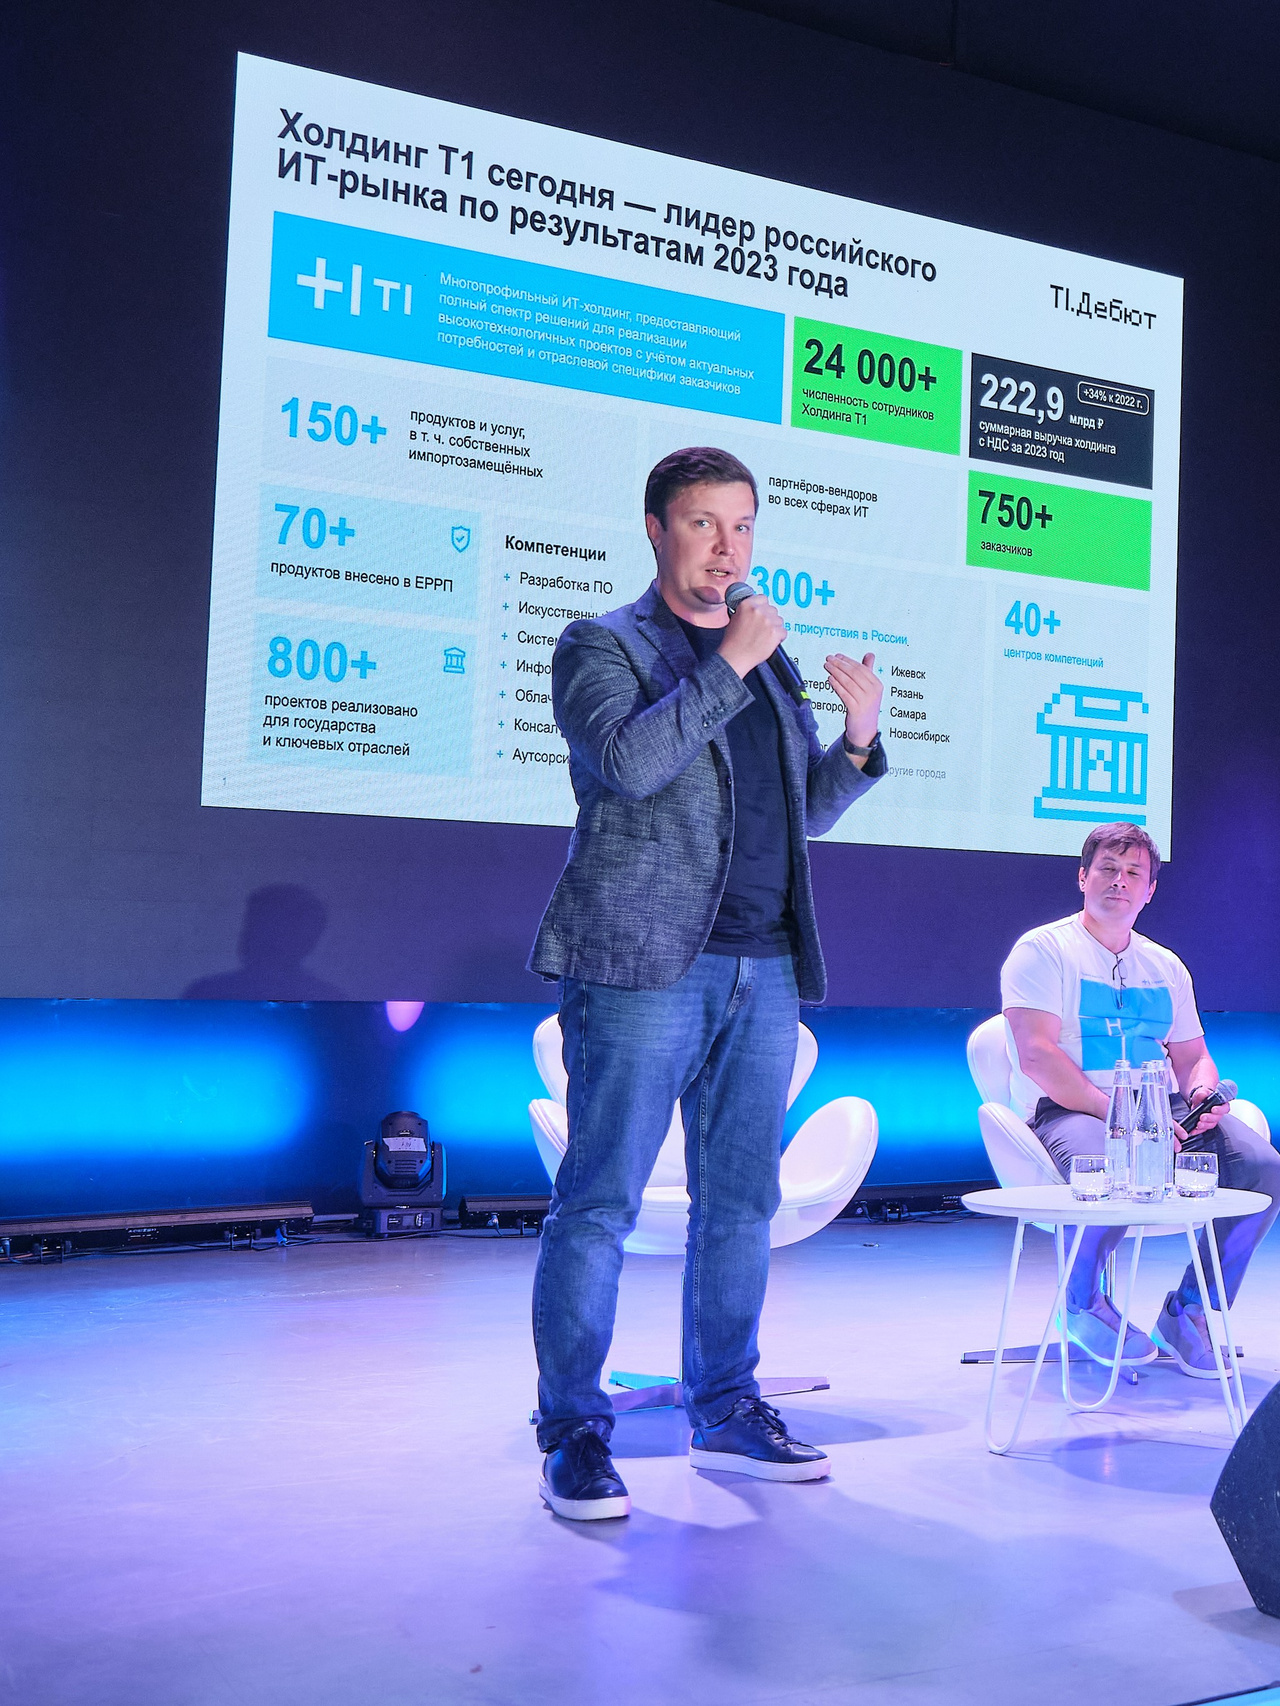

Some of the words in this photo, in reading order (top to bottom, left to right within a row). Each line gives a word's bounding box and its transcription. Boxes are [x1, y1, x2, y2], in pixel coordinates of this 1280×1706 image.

[277, 108, 428, 169] Холдинг
[438, 144, 473, 180] Т1
[488, 164, 614, 211] сегодня
[664, 203, 755, 247] лидер
[765, 225, 936, 282] российского
[278, 149, 447, 213] ИТ-рынка
[460, 194, 498, 222] по
[510, 205, 704, 267] результатам
[713, 243, 778, 282] 2023
[788, 265, 848, 299] года
[440, 272, 558, 306] Многопрофильный
[562, 296, 632, 322] ИТ-холдинг,
[636, 313, 740, 341] предоставляющий
[439, 294, 487, 311] полный
[491, 304, 532, 322] спектр
[535, 312, 589, 330] решений
[592, 323, 615, 335] для
[618, 328, 688, 349] реализации
[438, 313, 575, 347] высокотехнологичных
[579, 339, 632, 357] проектов
[636, 349, 643, 359] с
[645, 351, 686, 367] учётом
[689, 359, 754, 379] актуальных
[438, 332, 523, 356] потребностей
[528, 348, 535, 357] и
[538, 350, 608, 371] отраслевой
[612, 363, 676, 383] специфики
[680, 375, 740, 395] заказчиков
[804, 338, 845, 379] 24
[857, 349, 936, 392] 000+
[802, 388, 869, 408] численность
[872, 401, 934, 420] сотрудников
[980, 373, 1064, 424] 222,9
[1084, 388, 1107, 402] +34%
[1108, 393, 1114, 403] к
[1115, 393, 1135, 408] 2022
[1136, 400, 1143, 409] г.
[281, 397, 387, 446] 150+
[411, 411, 476, 430] продуктов
[480, 422, 487, 432] и
[491, 423, 525, 440] услуг,
[802, 403, 851, 423] Холдинга
[855, 412, 866, 425] Т1
[1070, 415, 1095, 430] млрд
[410, 430, 417, 440] в
[421, 432, 429, 442] т.
[434, 434, 444, 445] ч.
[449, 435, 530, 458] собственных
[979, 421, 1032, 439] суммарная
[1034, 431, 1072, 446] выручка
[1075, 438, 1116, 454] холдинга
[979, 437, 985, 446] с
[987, 436, 1009, 452] НДС
[1011, 443, 1022, 453] за
[1024, 443, 1047, 458] 2023
[1050, 450, 1064, 463] год
[409, 449, 543, 478] импортозамещённых
[769, 477, 877, 503] партнёров-вендоров
[768, 494, 781, 505] во
[784, 497, 808, 509] всех
[811, 500, 850, 516] сферах
[854, 505, 869, 518] ИТ
[979, 489, 1053, 531] 750+
[275, 503, 356, 549] 70+
[506, 535, 606, 562] Компетенции
[981, 541, 1032, 557] заказчиков
[271, 562, 340, 580] продуктов
[345, 571, 399, 586] внесено
[404, 578, 411, 588] в
[415, 575, 453, 592] ЕРРП
[520, 571, 589, 592] Разработка
[594, 580, 613, 594] ПО
[751, 565, 835, 608] 300+
[519, 601, 610, 620] Искусственн
[1005, 600, 1061, 637] 40+
[794, 623, 859, 639] присутствия
[862, 631, 868, 640] в
[871, 630, 907, 646] России
[267, 635, 377, 683] 800+
[1004, 648, 1042, 662] центров
[1045, 653, 1103, 668] компетенций
[892, 666, 926, 679] Ижевск
[265, 695, 327, 710] проектов
[332, 700, 418, 717] реализовано
[891, 686, 924, 700] Рязань
[263, 715, 289, 728] для
[294, 718, 376, 734] государства
[515, 718, 557, 733] Консал
[890, 706, 926, 722] Самара
[263, 735, 271, 746] и
[276, 737, 344, 751] ключевых
[348, 742, 409, 756] отраслей
[890, 727, 950, 744] Новосибирск
[513, 748, 569, 765] Аутсорси
[889, 766, 914, 777] ругие
[916, 769, 946, 779] города
